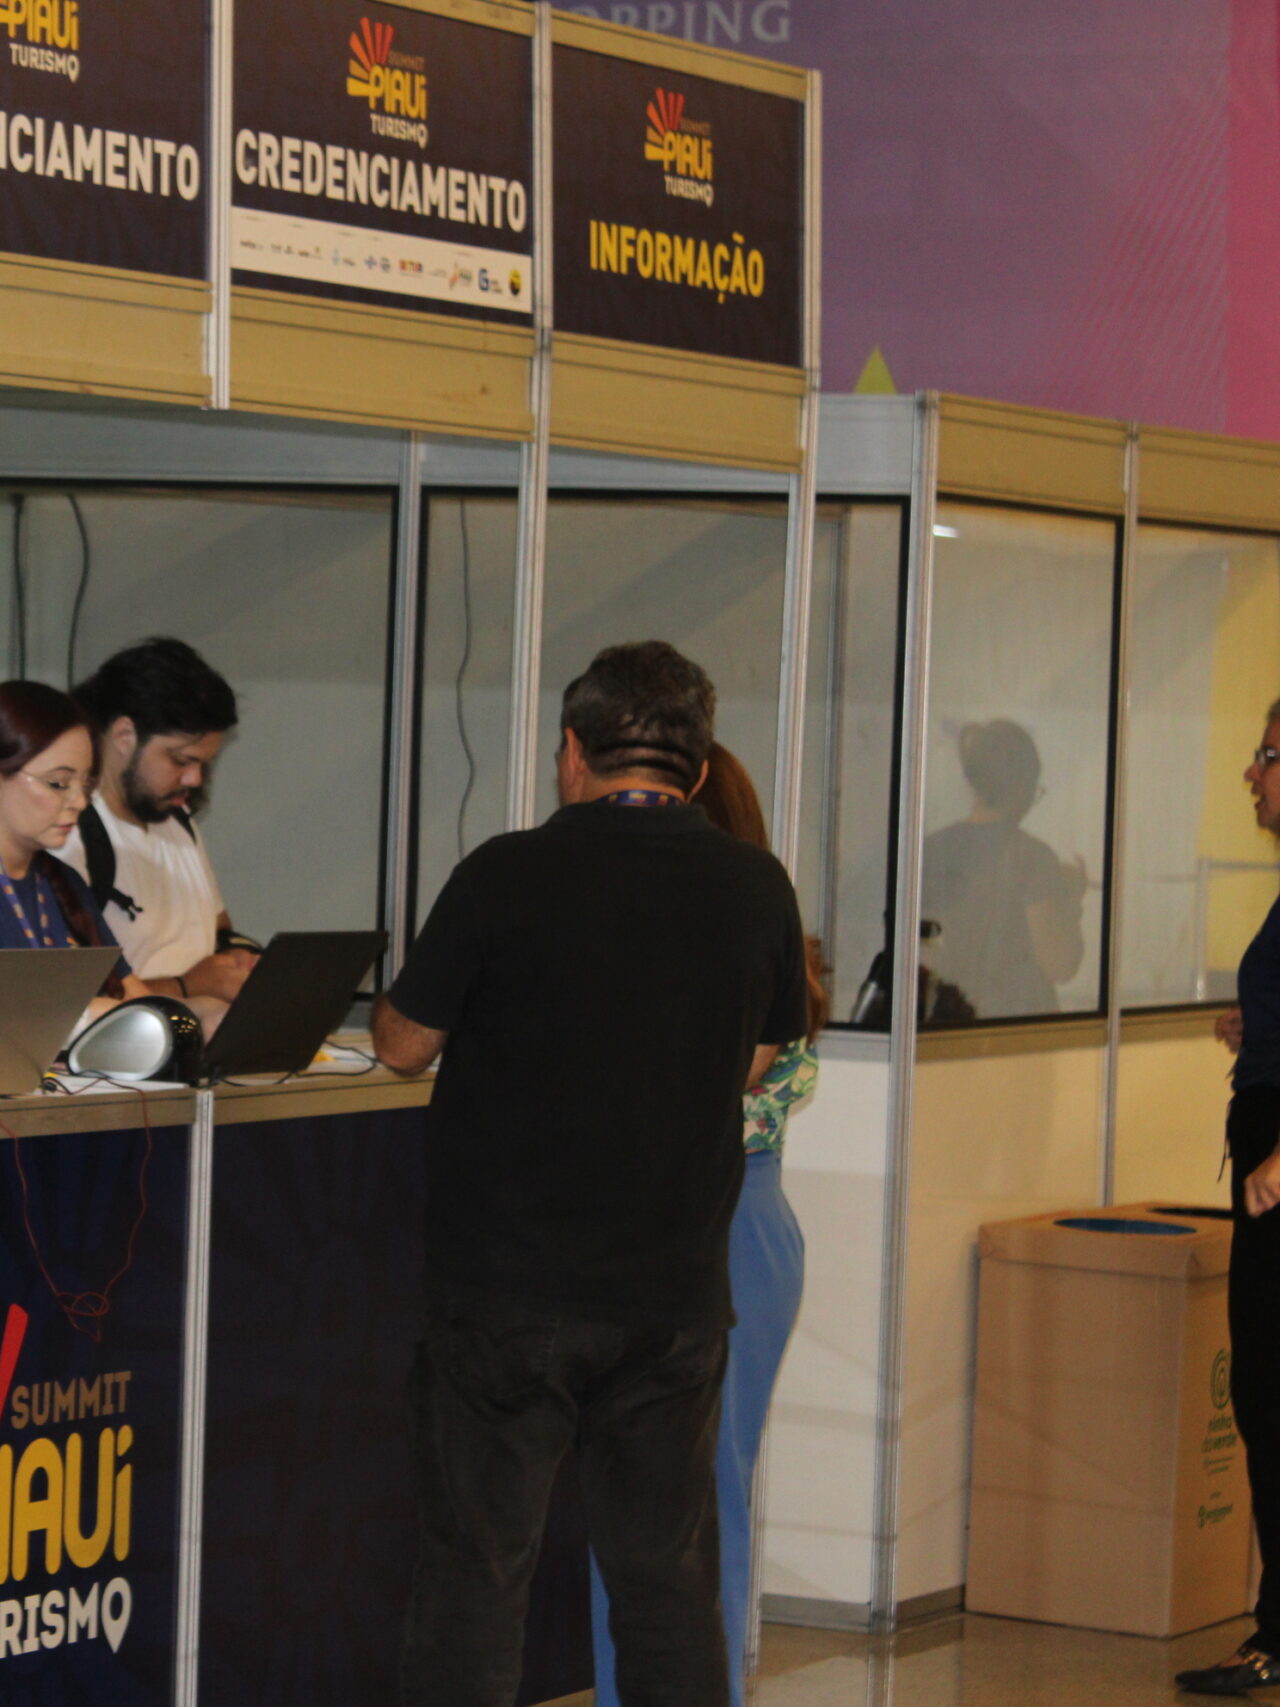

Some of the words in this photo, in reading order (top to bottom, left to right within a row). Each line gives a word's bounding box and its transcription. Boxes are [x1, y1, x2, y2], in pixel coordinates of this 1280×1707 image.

[9, 42, 81, 83] TURISMO
[370, 113, 429, 149] TURISMO
[235, 128, 527, 233] CREDENCIAMENTO
[589, 219, 765, 304] INFORMAÇÃO
[11, 1370, 132, 1429] SUMMIT
